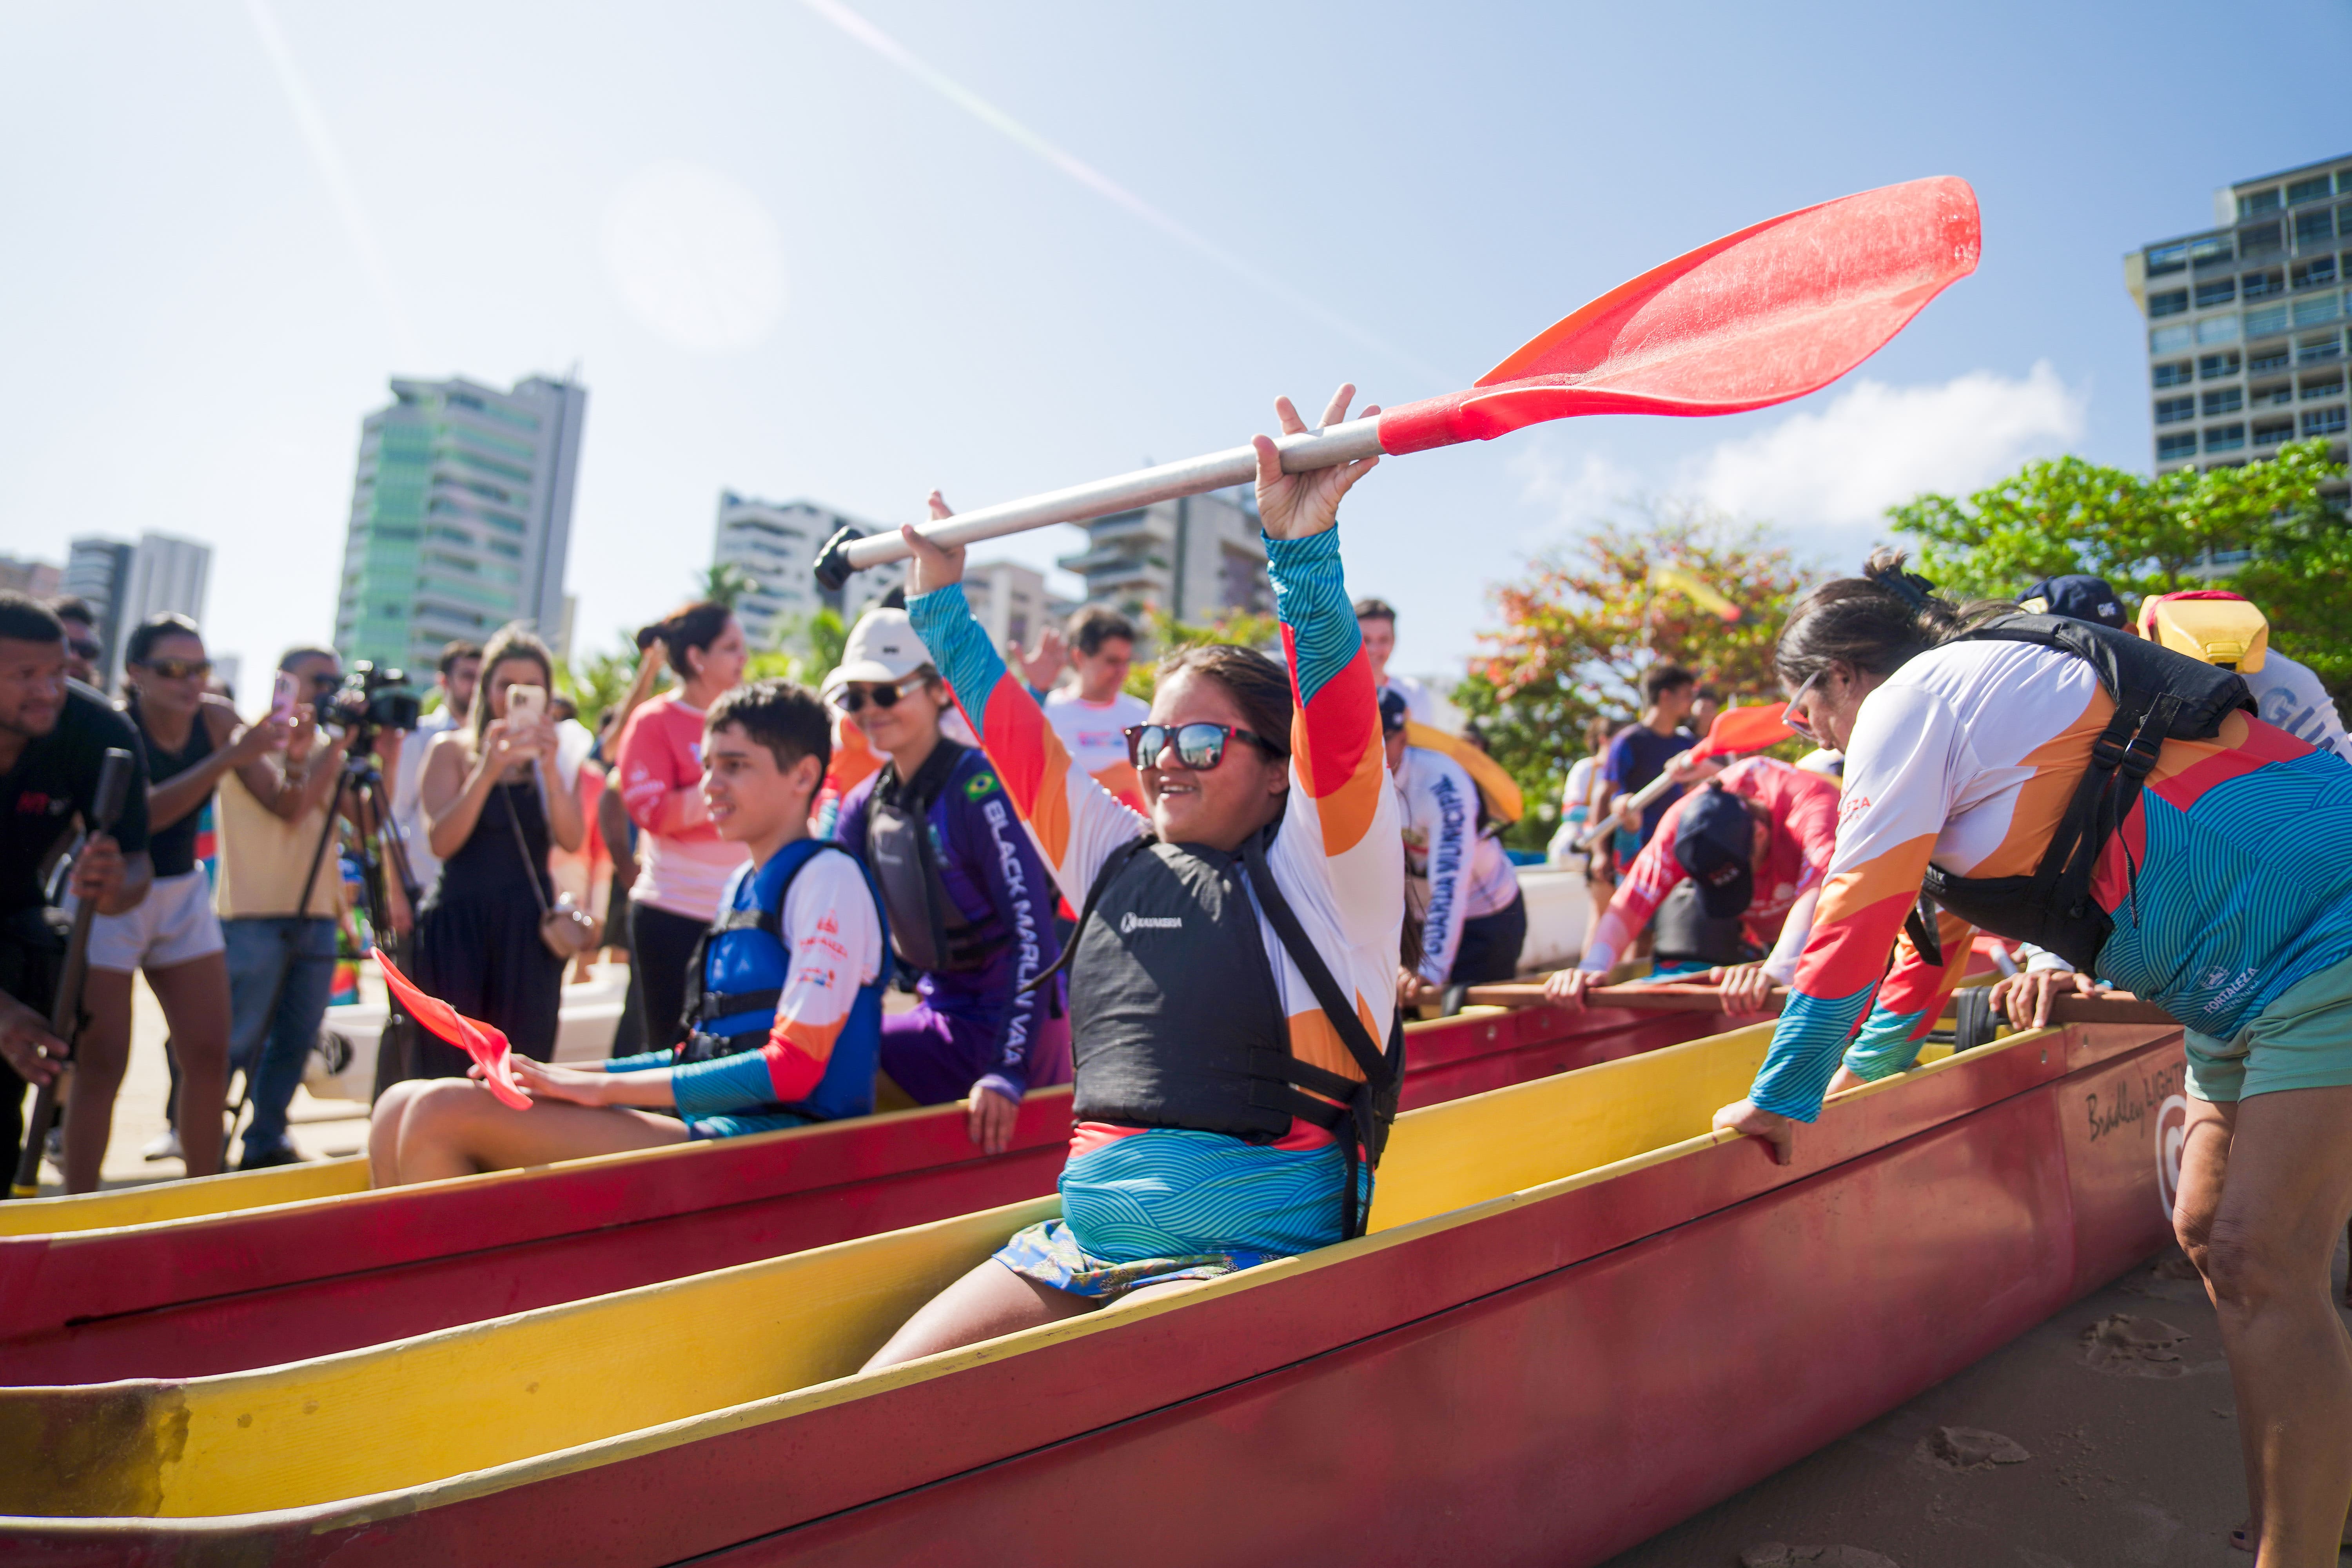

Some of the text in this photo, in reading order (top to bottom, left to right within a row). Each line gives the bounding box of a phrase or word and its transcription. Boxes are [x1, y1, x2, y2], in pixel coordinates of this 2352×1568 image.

[982, 799, 1028, 898] BLACK
[1013, 899, 1040, 1008] MARLIN
[1423, 877, 1456, 955] GUARDA
[2203, 967, 2260, 1014] FORTALEZA
[2220, 980, 2260, 1014] PREFEITURA
[2085, 1081, 2145, 1142] Bradley
